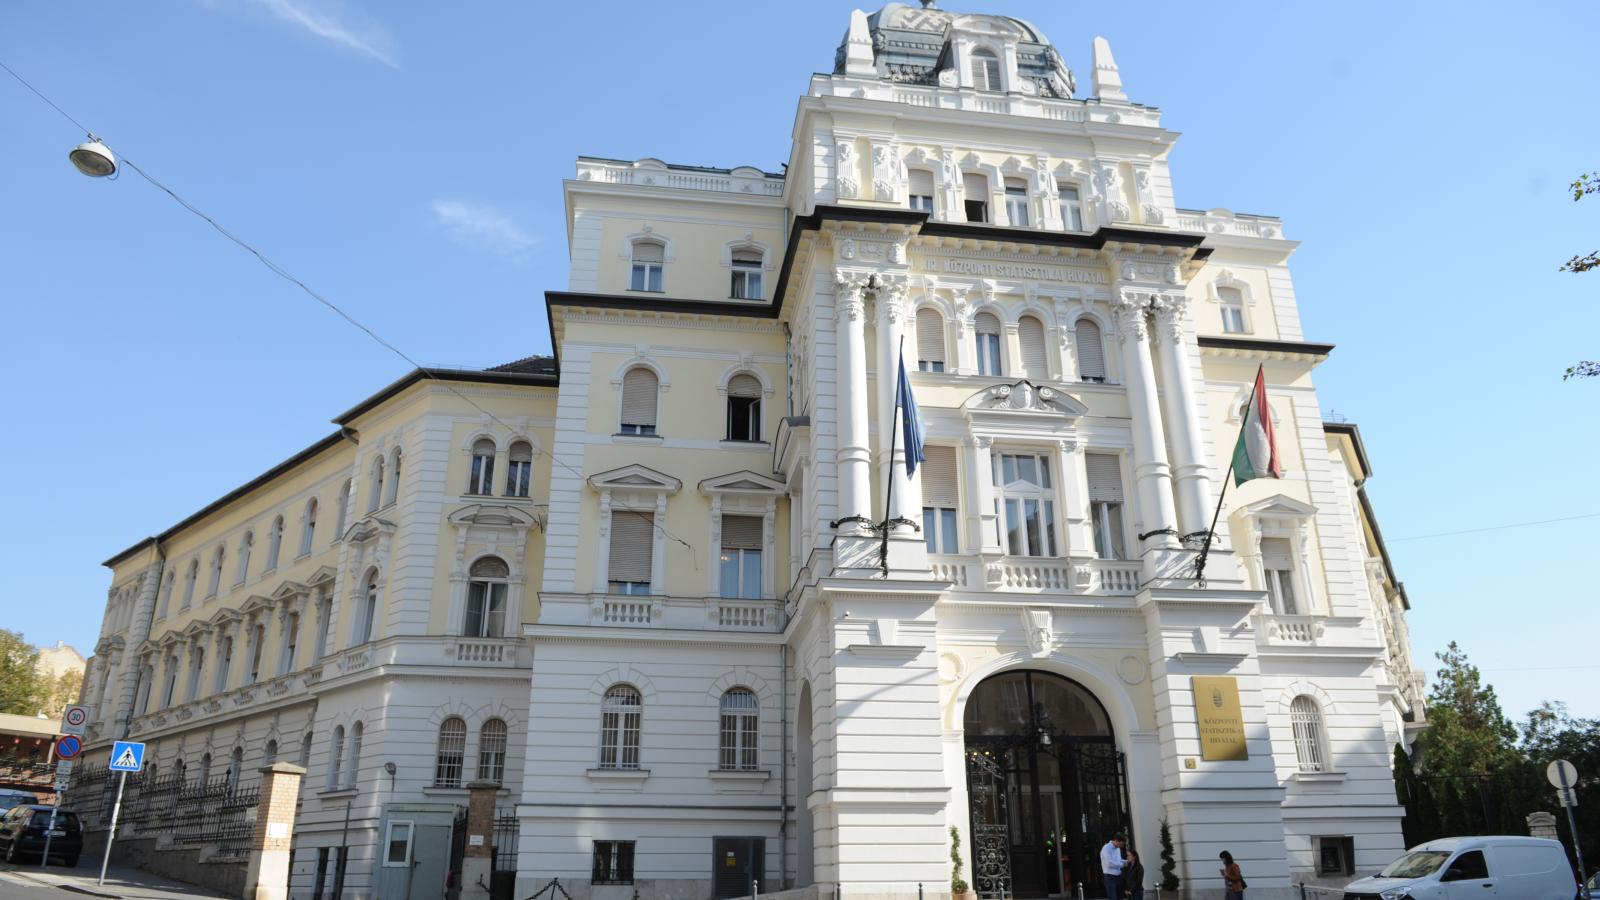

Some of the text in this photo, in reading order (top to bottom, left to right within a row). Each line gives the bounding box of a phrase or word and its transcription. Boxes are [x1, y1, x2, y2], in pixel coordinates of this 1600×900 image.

[996, 263, 1065, 281] STATISZTIKAI
[1067, 269, 1109, 286] HIVATAL
[71, 713, 81, 722] 30
